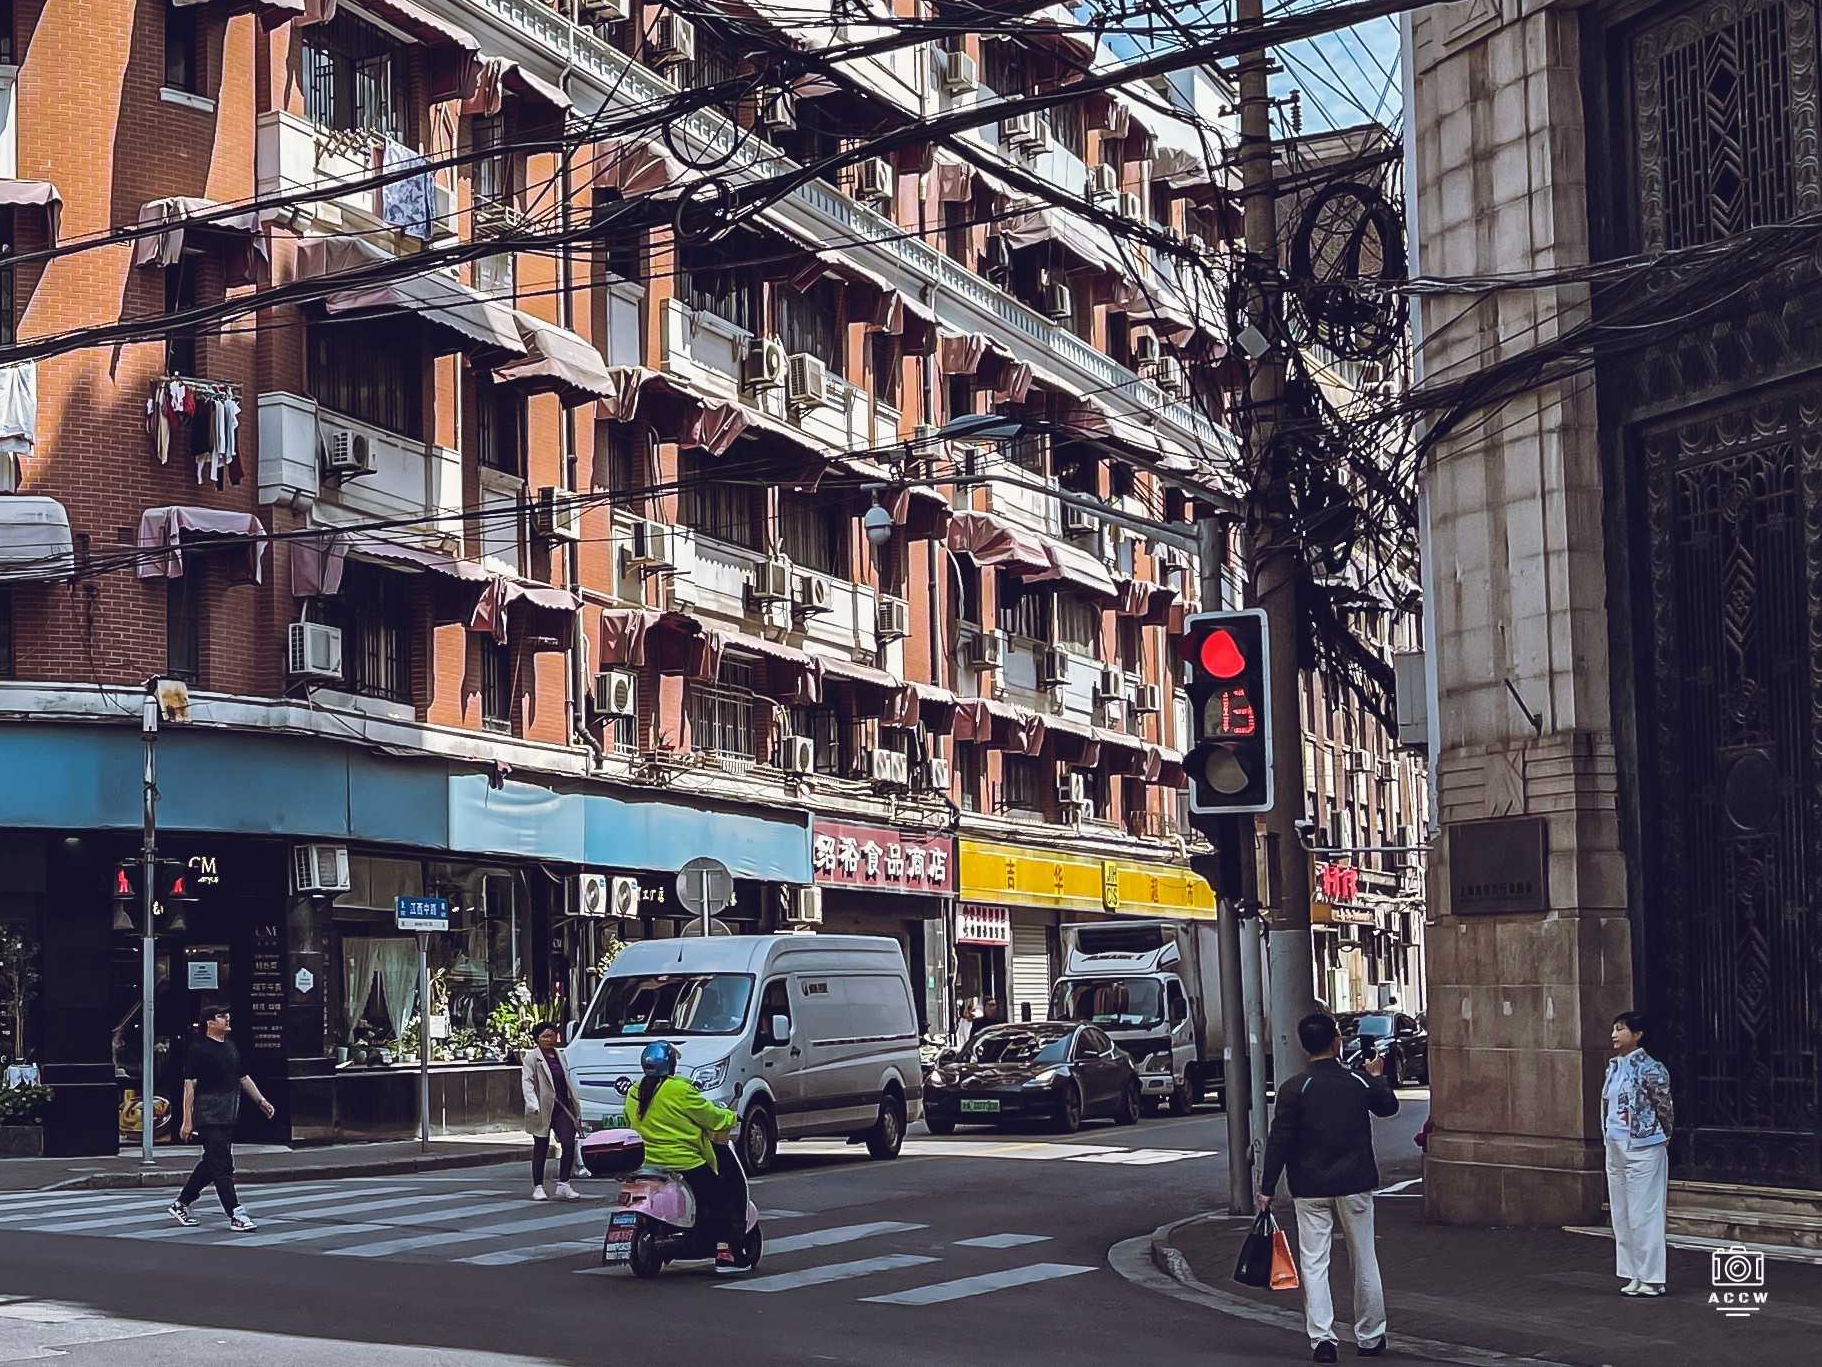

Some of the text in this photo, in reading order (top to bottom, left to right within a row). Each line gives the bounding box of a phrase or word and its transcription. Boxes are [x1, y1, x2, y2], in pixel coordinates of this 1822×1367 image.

[813, 834, 948, 882] 绍裕食品商店
